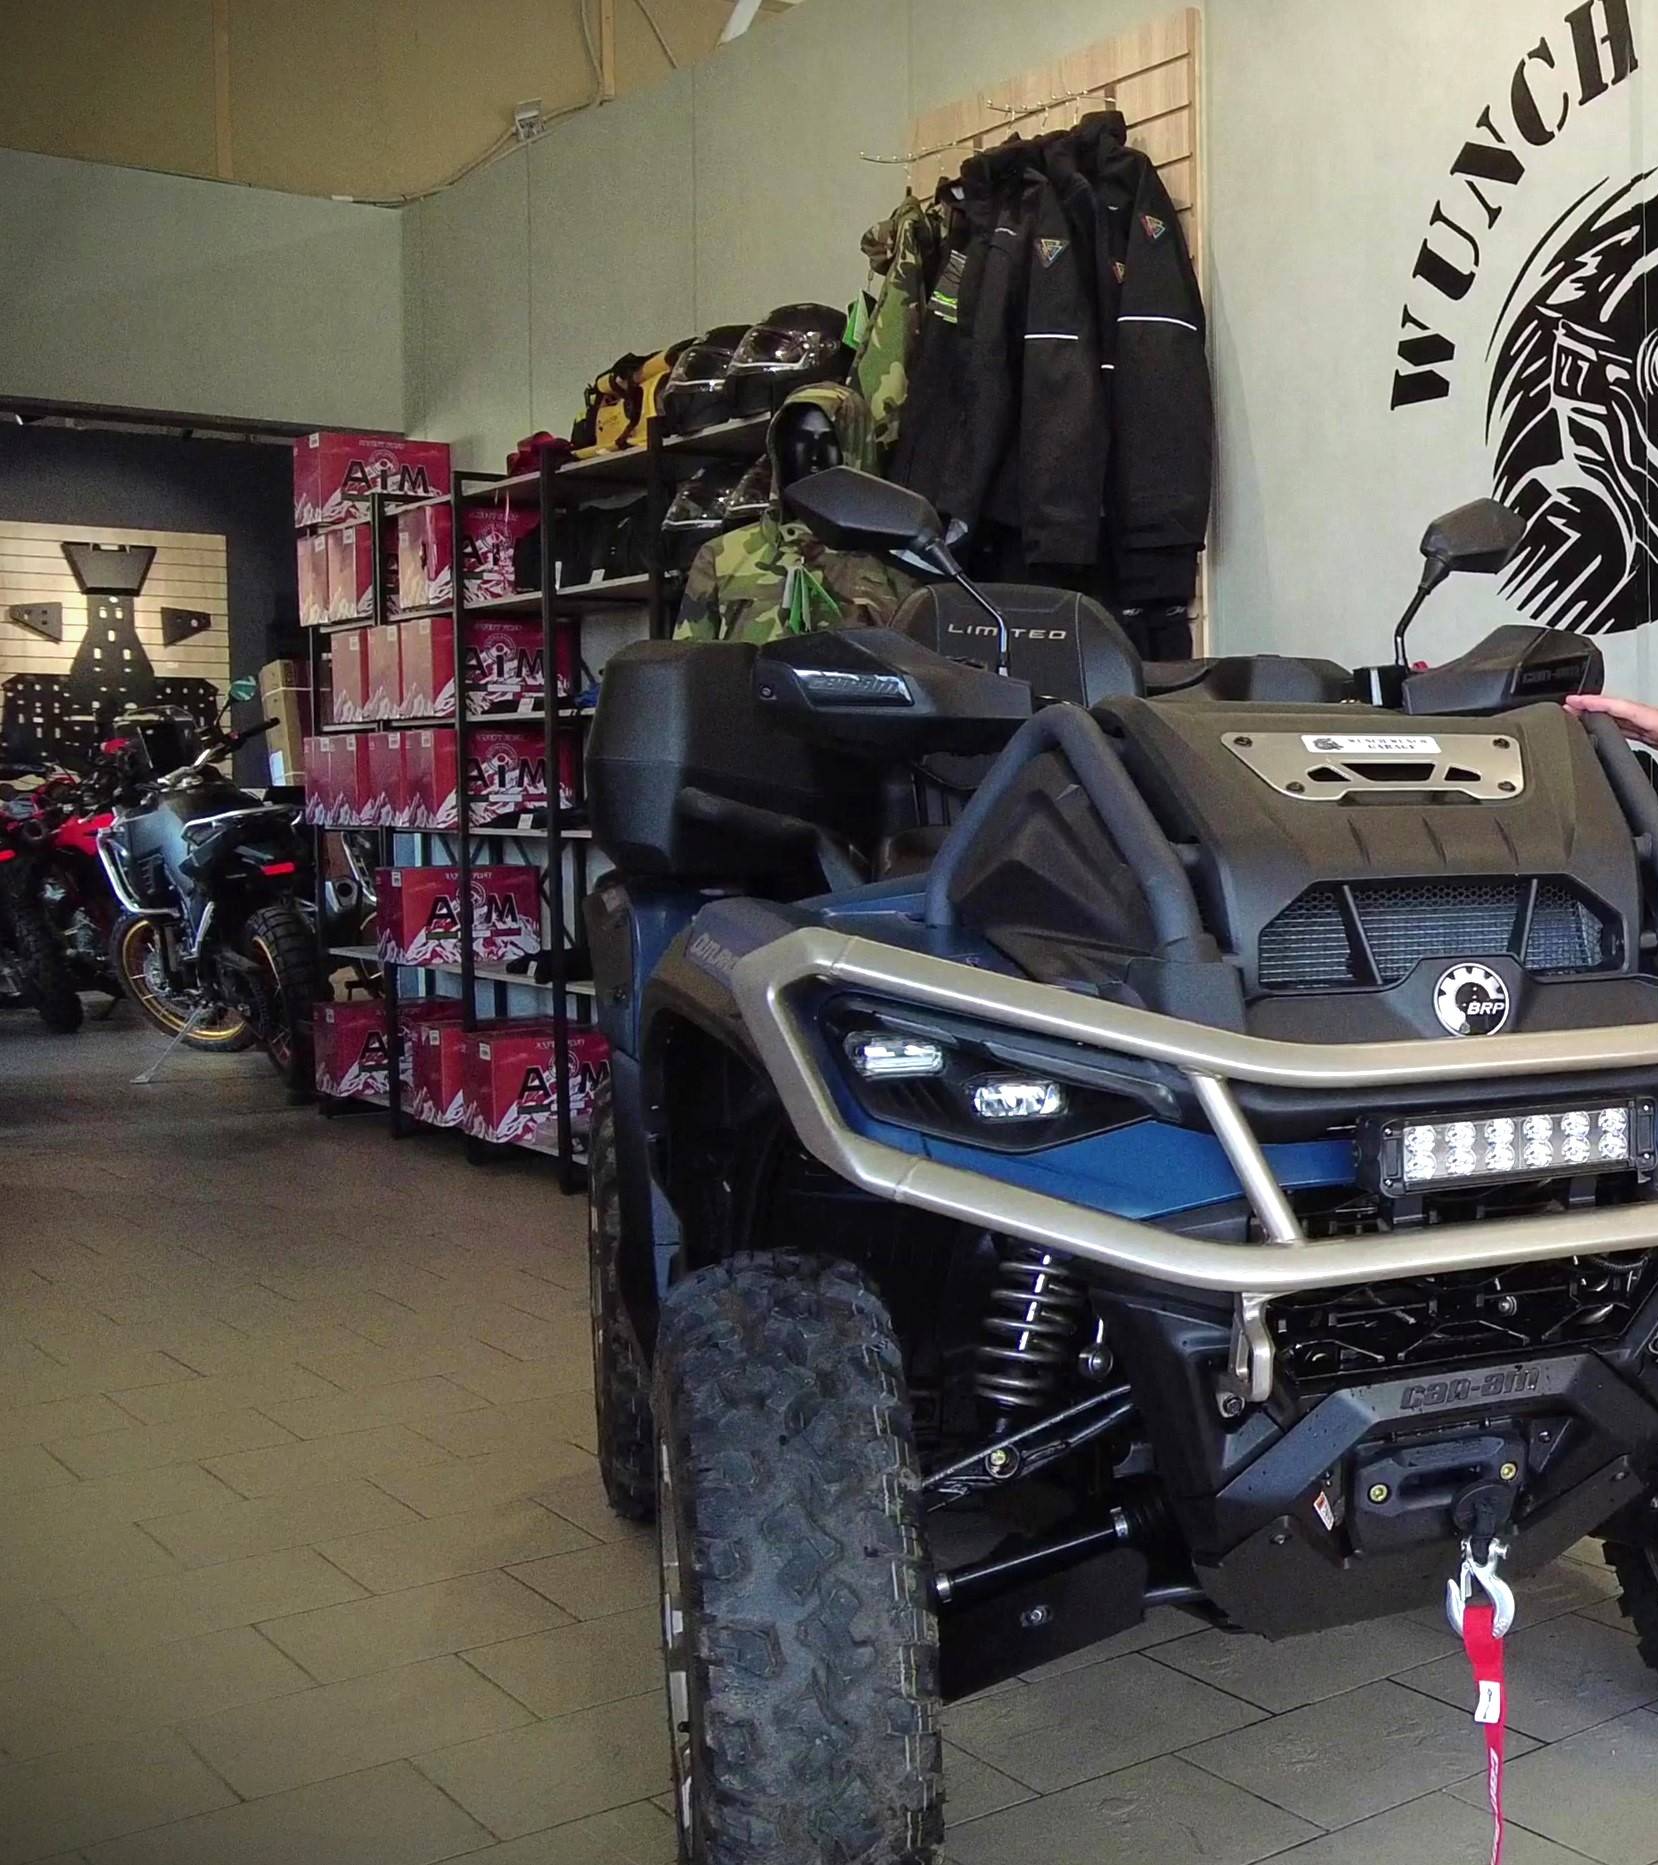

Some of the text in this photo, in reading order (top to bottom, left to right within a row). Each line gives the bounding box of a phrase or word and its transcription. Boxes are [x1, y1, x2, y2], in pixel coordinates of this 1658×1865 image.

[1390, 0, 1640, 411] WUNCH
[948, 624, 1066, 640] LIMTED
[424, 891, 521, 930] AM
[1467, 1002, 1504, 1015] BRP
[1400, 1367, 1539, 1409] can-am
